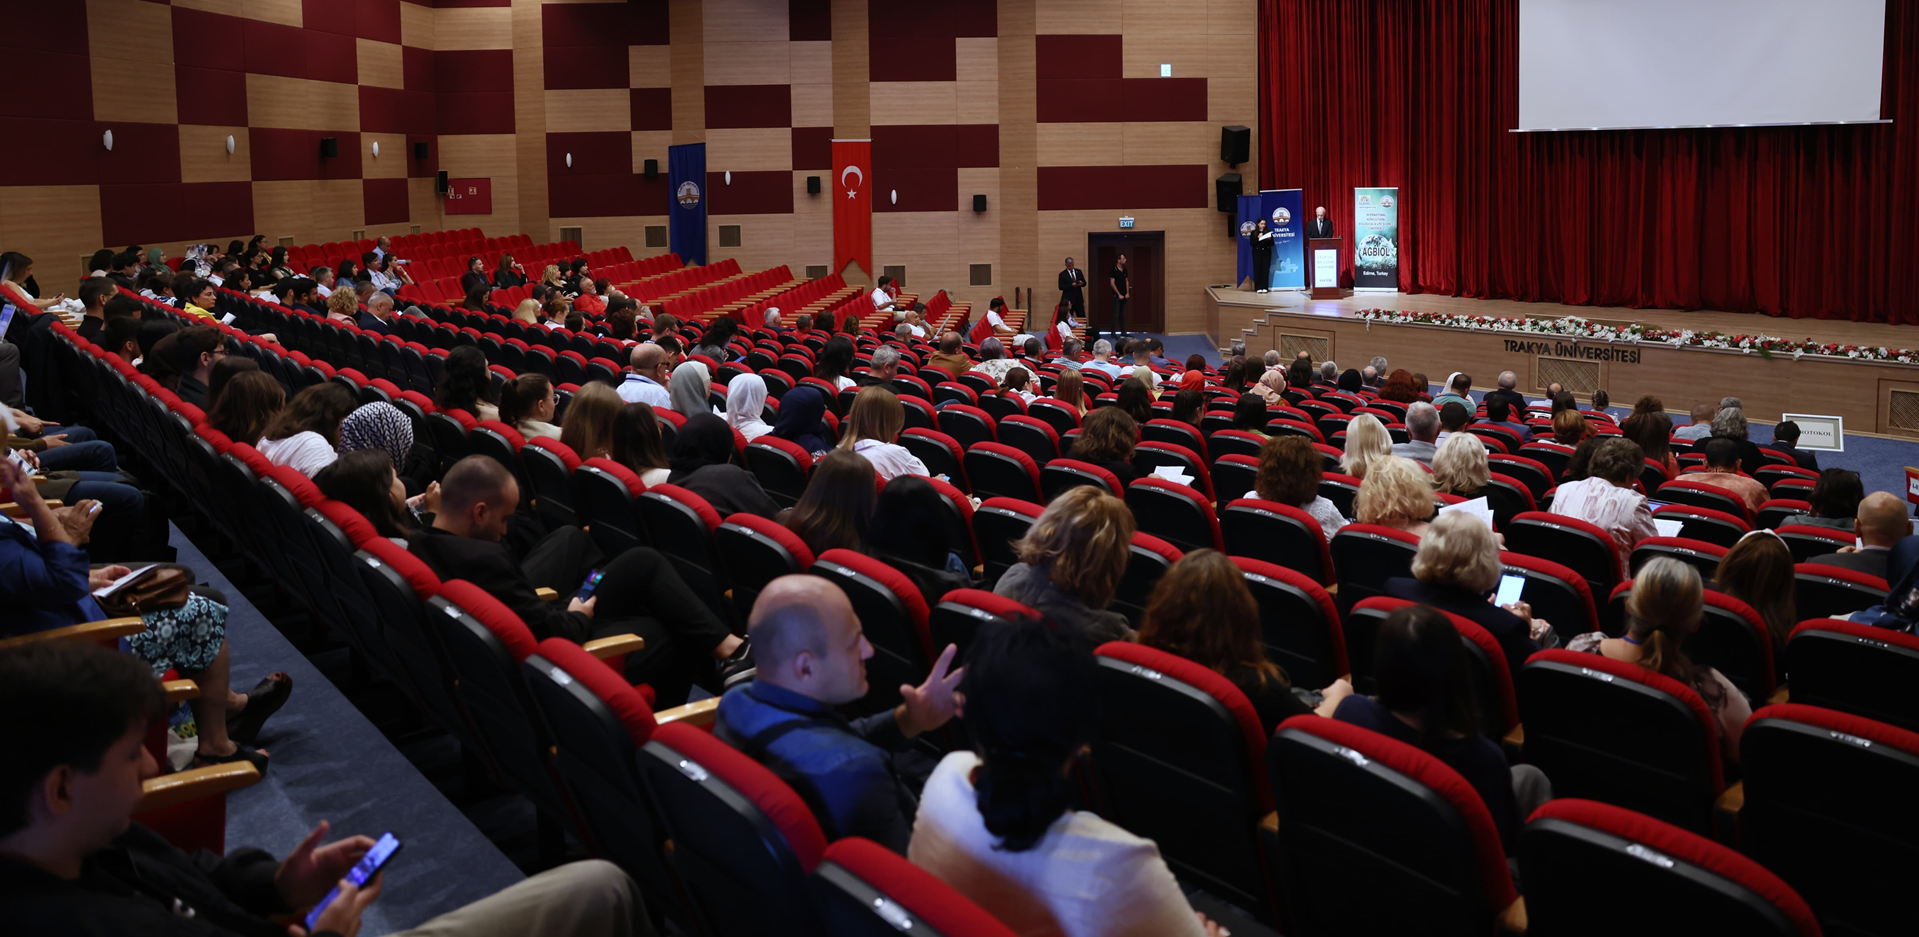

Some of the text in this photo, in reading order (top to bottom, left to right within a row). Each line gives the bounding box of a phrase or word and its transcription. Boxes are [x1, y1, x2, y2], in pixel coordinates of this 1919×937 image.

[1119, 200, 1134, 208] EXIT
[1362, 247, 1390, 257] AGBIOL
[1504, 339, 1641, 364] TRAKYA ÜNİVERSİTESİ
